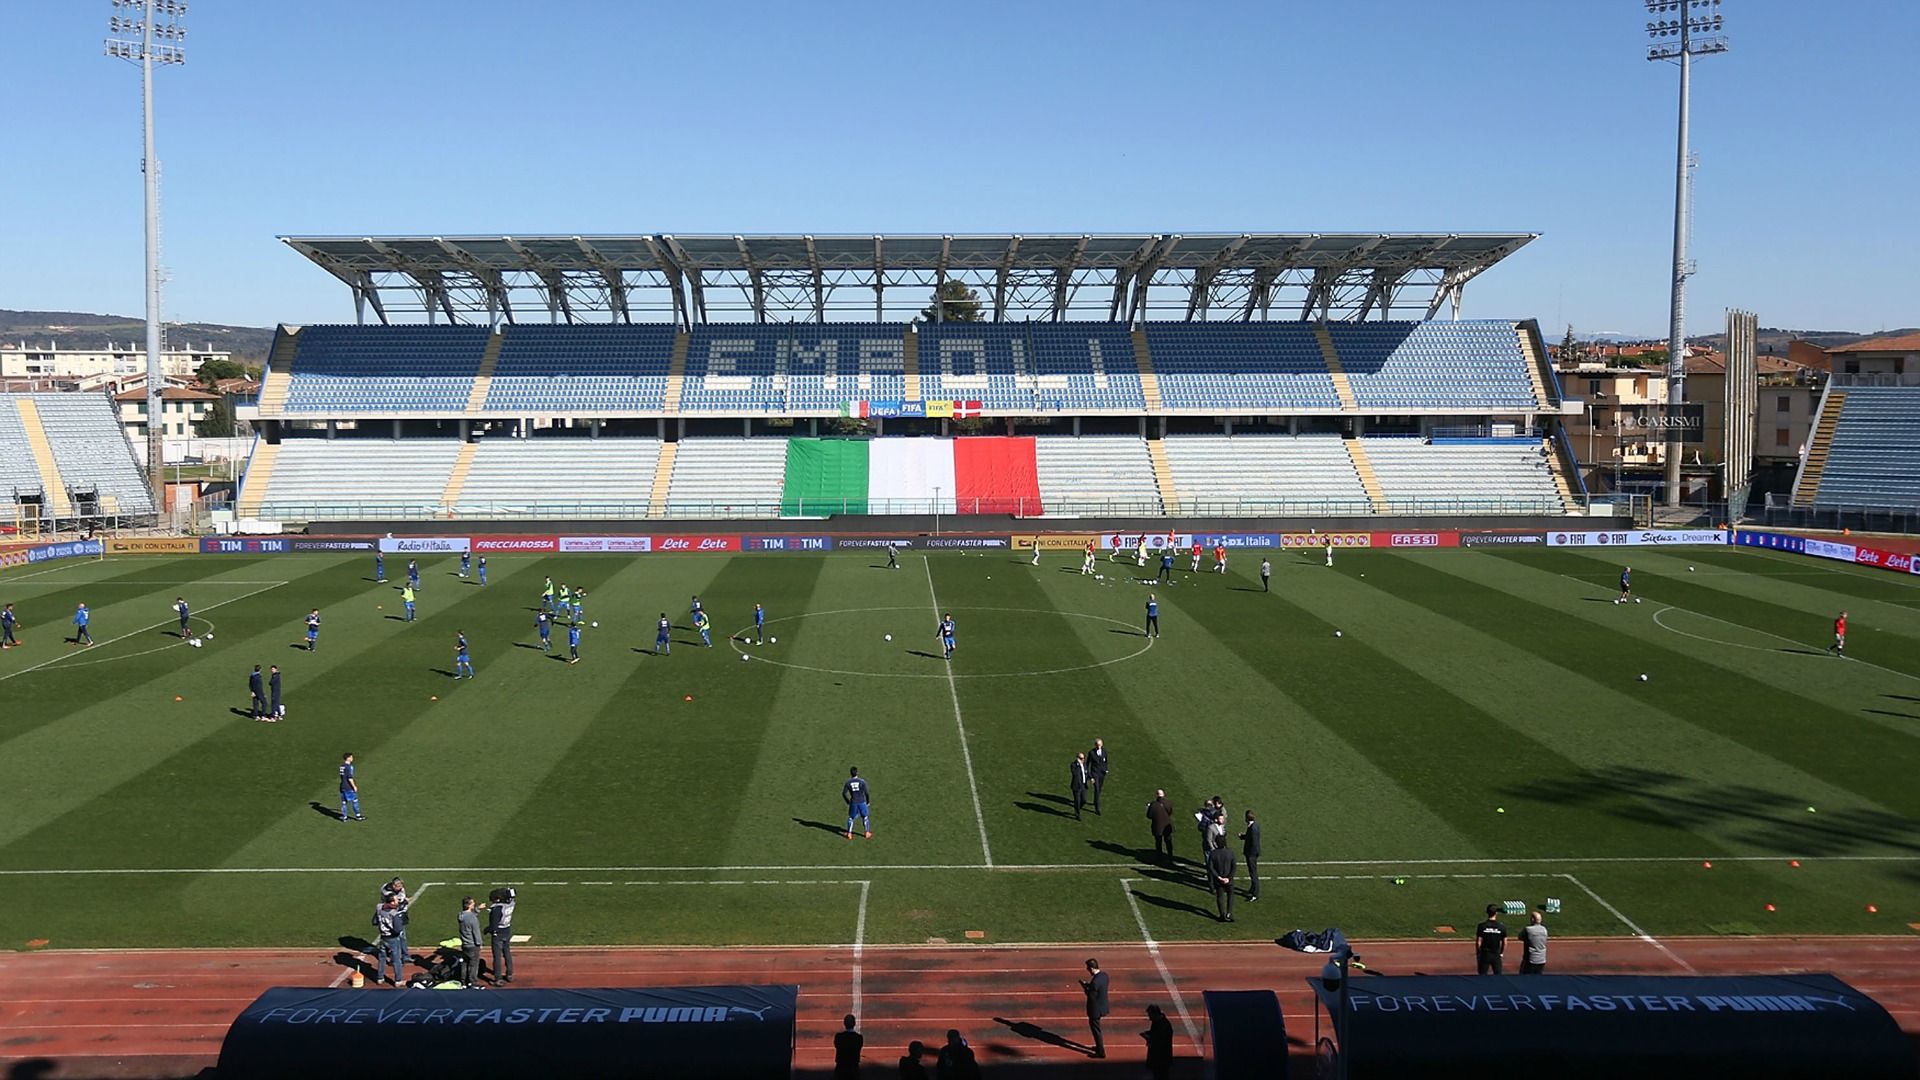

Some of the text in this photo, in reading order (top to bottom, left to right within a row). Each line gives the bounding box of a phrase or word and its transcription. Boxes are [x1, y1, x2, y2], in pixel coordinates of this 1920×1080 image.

[702, 338, 1110, 390] EMPOLI
[871, 407, 896, 417] UEFA
[902, 404, 922, 412] FIFA
[1638, 416, 1700, 427] CARISMI
[659, 538, 690, 549] Lete
[697, 538, 728, 549] Lete
[762, 539, 784, 549] TIM
[801, 539, 823, 549] TIM
[1125, 537, 1141, 547] FIA
[1246, 536, 1270, 546] Italia
[1395, 536, 1435, 544] FASSI
[1570, 534, 1586, 544] FIAT
[1612, 534, 1628, 544] FIAT
[219, 541, 242, 550] TIM
[260, 541, 282, 550] TIM
[398, 540, 421, 550] Radio
[476, 541, 554, 549] FRECCIAROSSA
[1857, 549, 1880, 563] Lete
[1885, 554, 1910, 568] Lete
[1695, 995, 1817, 1011] PUMA
[618, 1006, 731, 1023] PUMA
